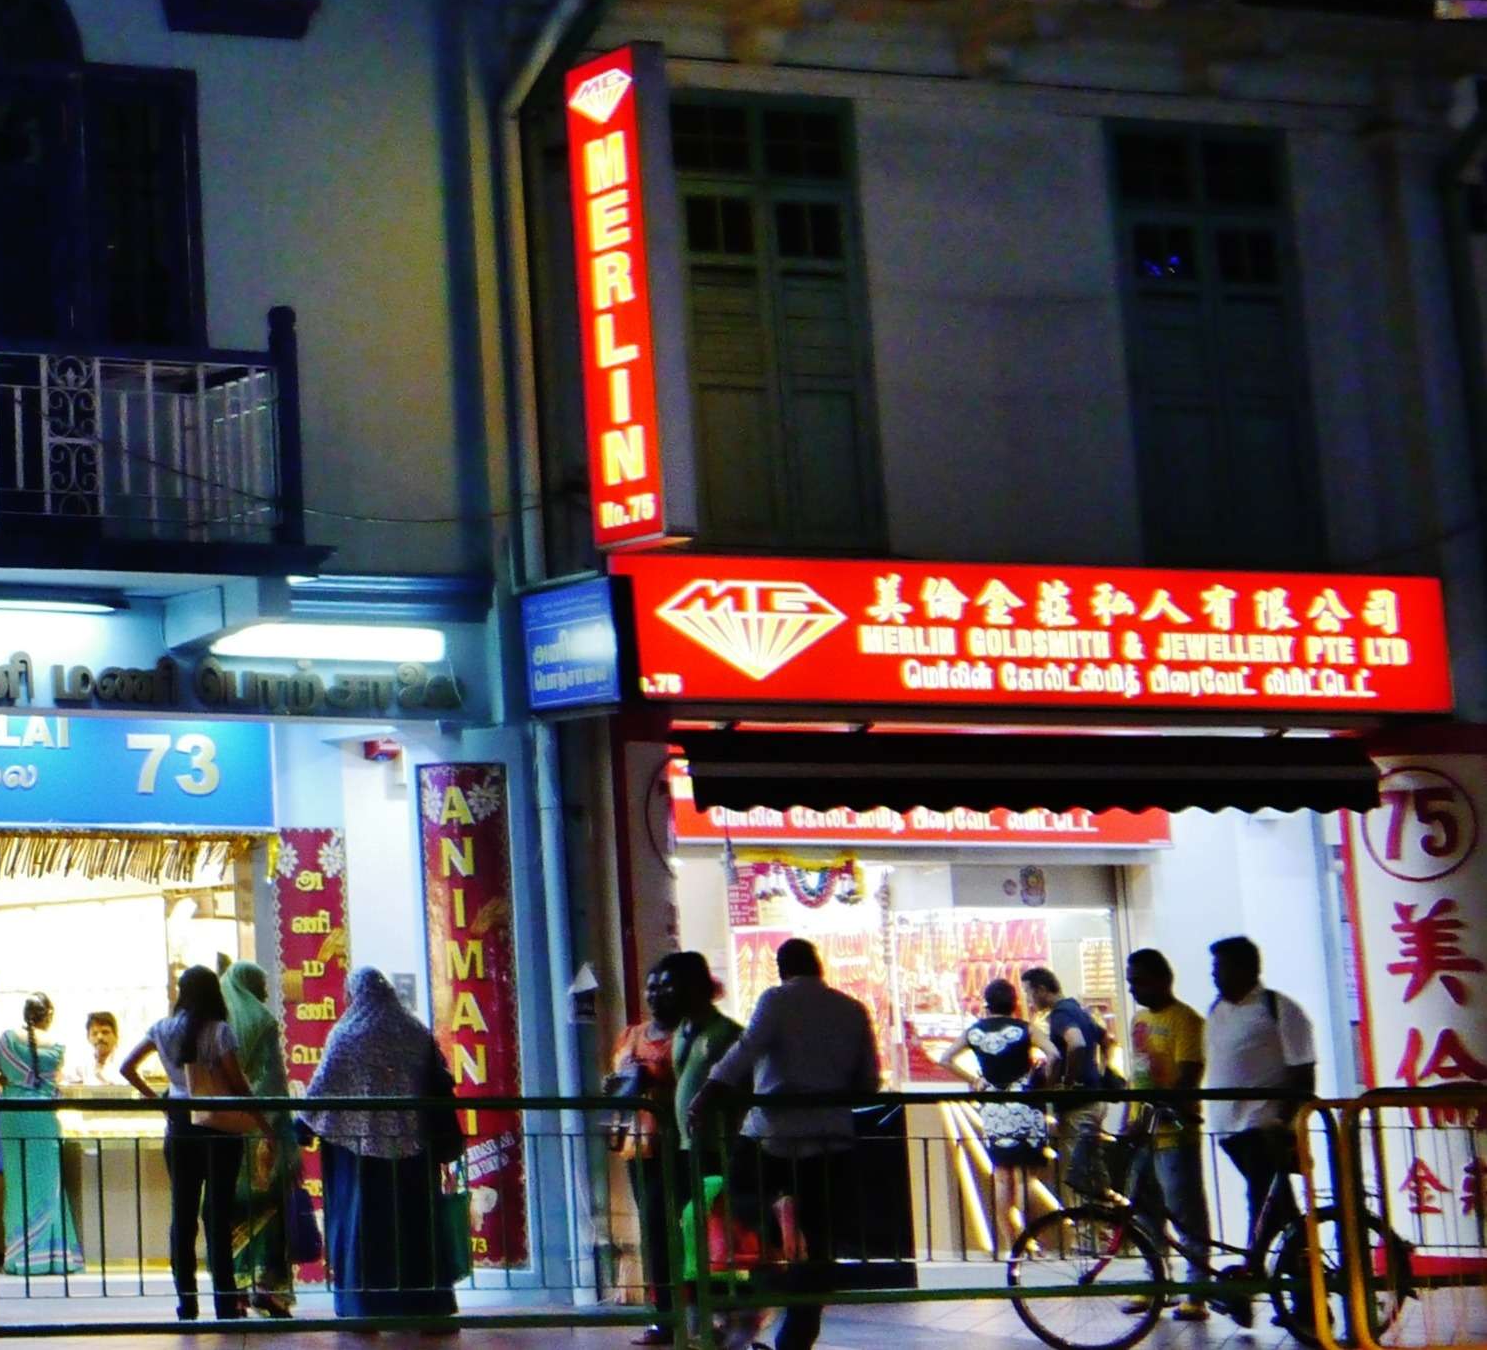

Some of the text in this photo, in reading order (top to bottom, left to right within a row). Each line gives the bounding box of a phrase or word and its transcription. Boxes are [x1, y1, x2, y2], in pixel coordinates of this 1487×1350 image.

[584, 130, 647, 486] MERLIN
[857, 624, 1410, 666] MERLIN GOLDSMITH & JEWELLERY PTE LTD
[126, 731, 221, 796] 73
[1381, 786, 1458, 860] 75
[439, 785, 488, 1137] ANIMANI
